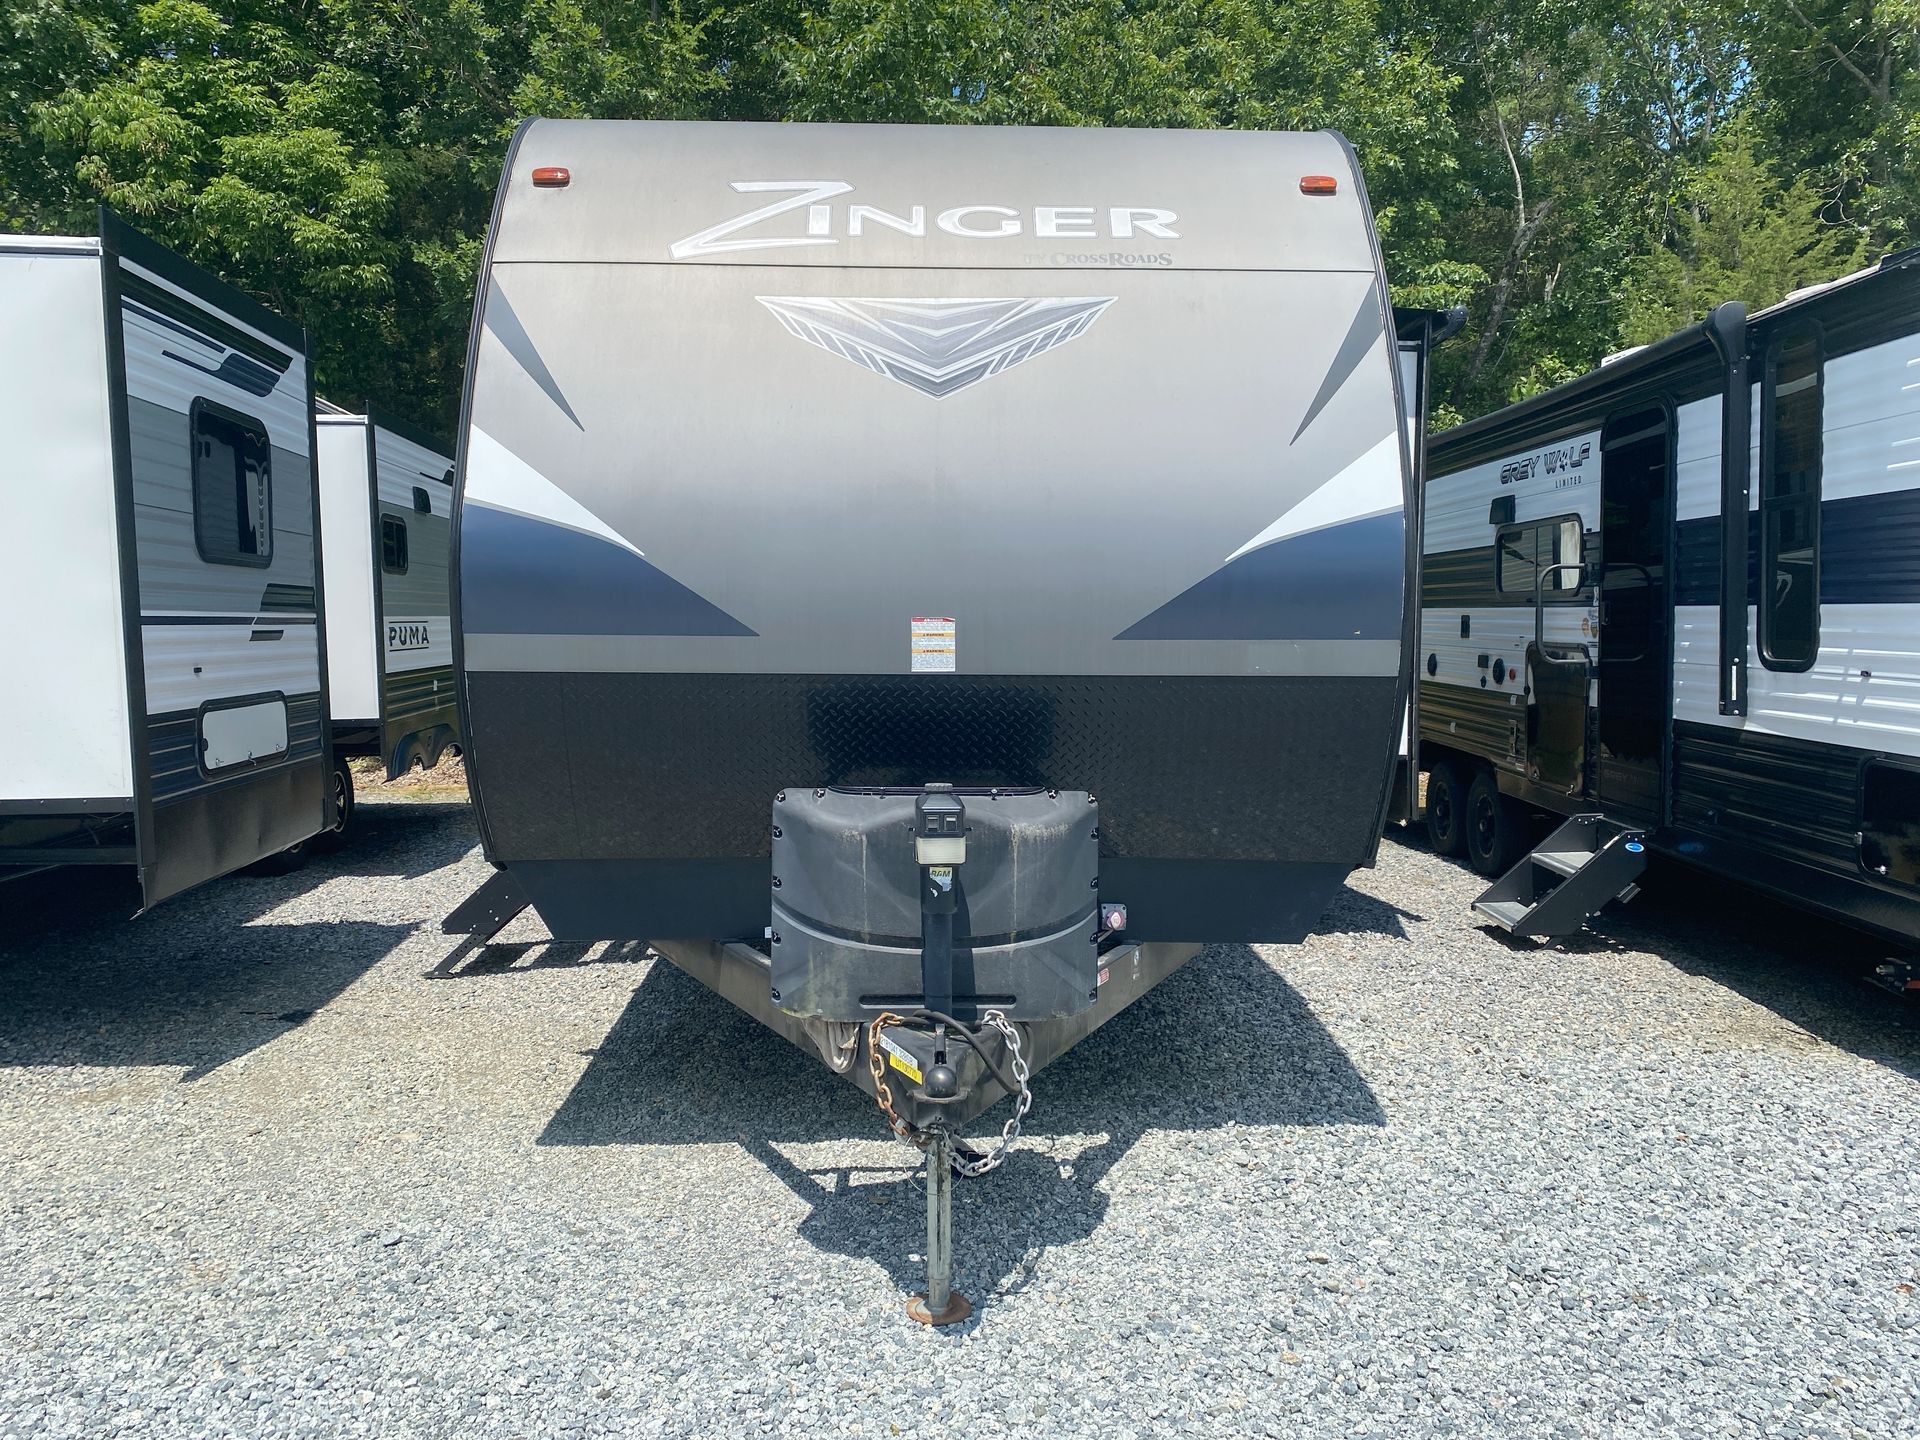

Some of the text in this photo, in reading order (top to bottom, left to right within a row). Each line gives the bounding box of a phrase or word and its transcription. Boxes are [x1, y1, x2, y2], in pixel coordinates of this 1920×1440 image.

[667, 179, 1183, 260] ZINGER
[1051, 252, 1173, 267] CROSSROADS
[1500, 455, 1540, 485] GREY
[1555, 475, 1582, 489] LIMITED
[389, 626, 430, 647] PUMA
